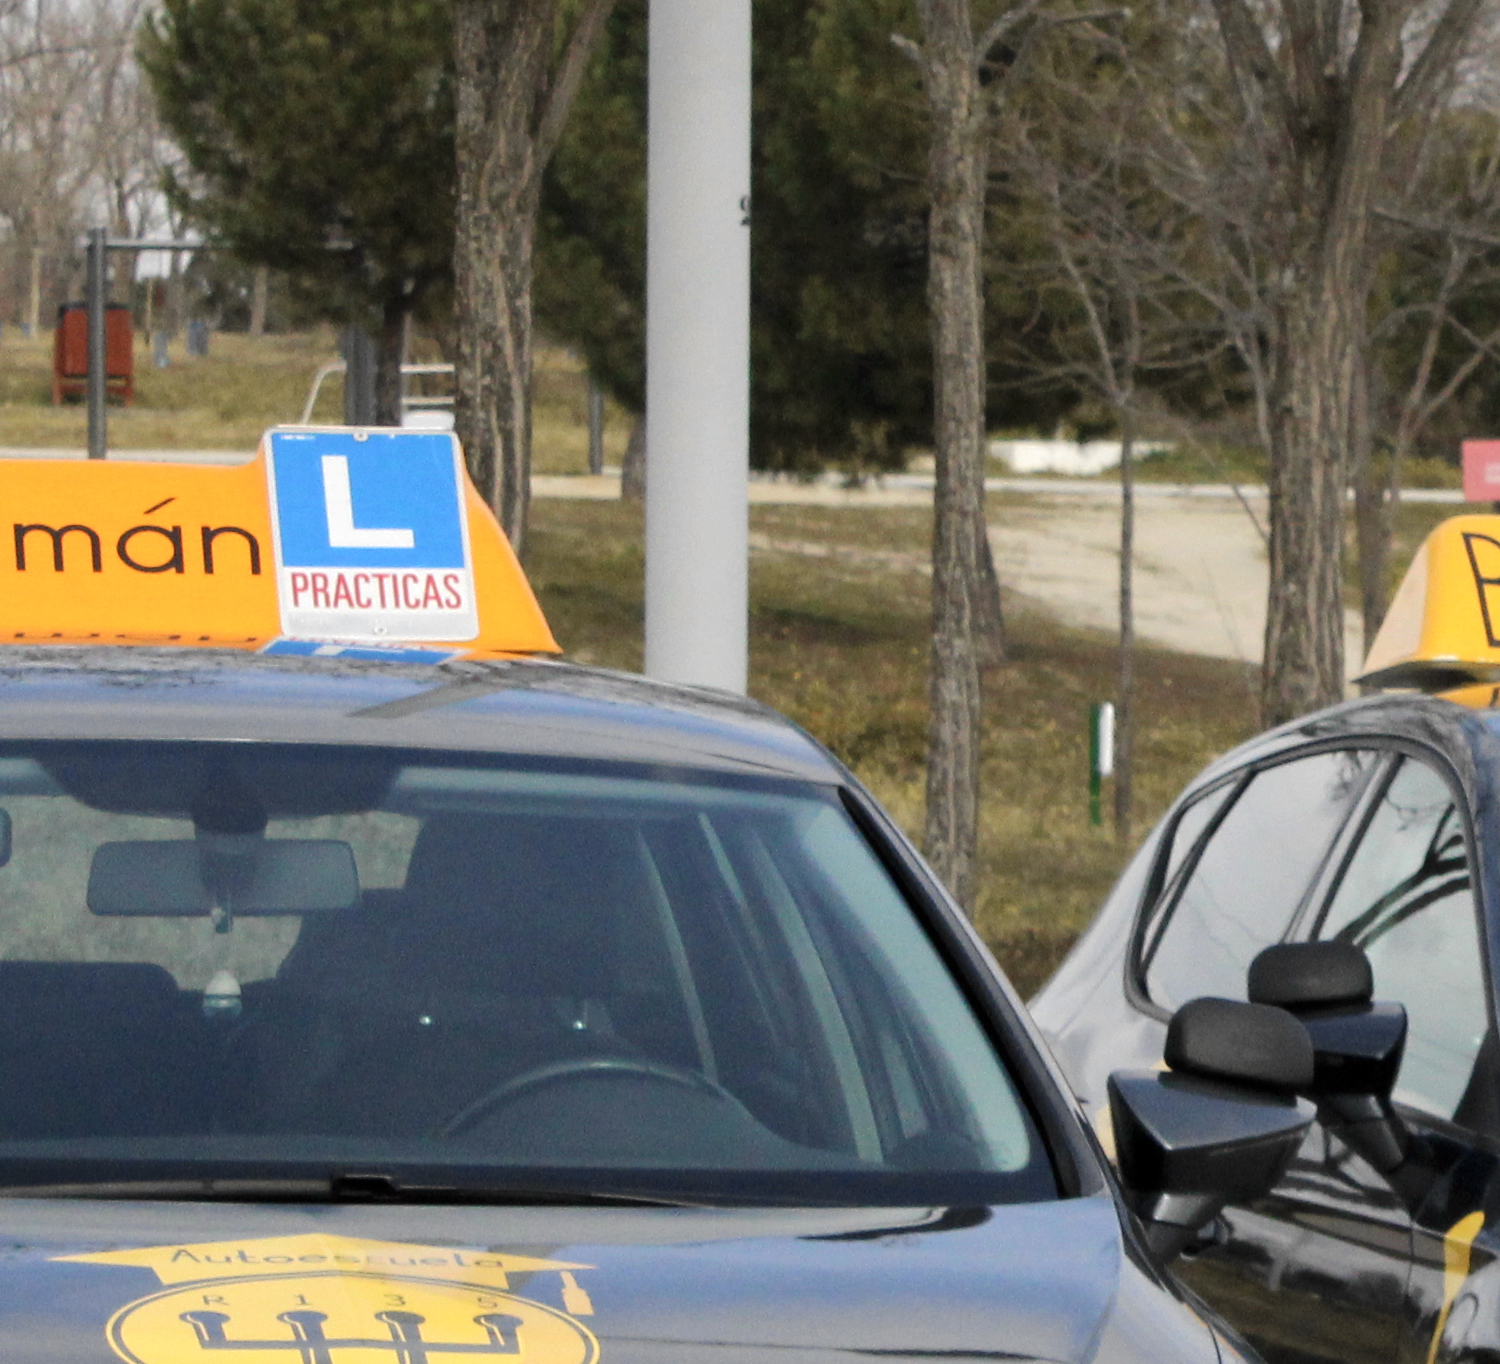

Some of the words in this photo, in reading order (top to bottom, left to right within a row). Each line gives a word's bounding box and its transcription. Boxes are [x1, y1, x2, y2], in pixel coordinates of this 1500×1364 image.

[321, 455, 415, 548] L
[290, 572, 462, 609] PRACTICAS
[170, 1248, 503, 1268] Autoescuela
[202, 1294, 229, 1306] R
[294, 1293, 312, 1306] 1
[384, 1294, 407, 1306] 3
